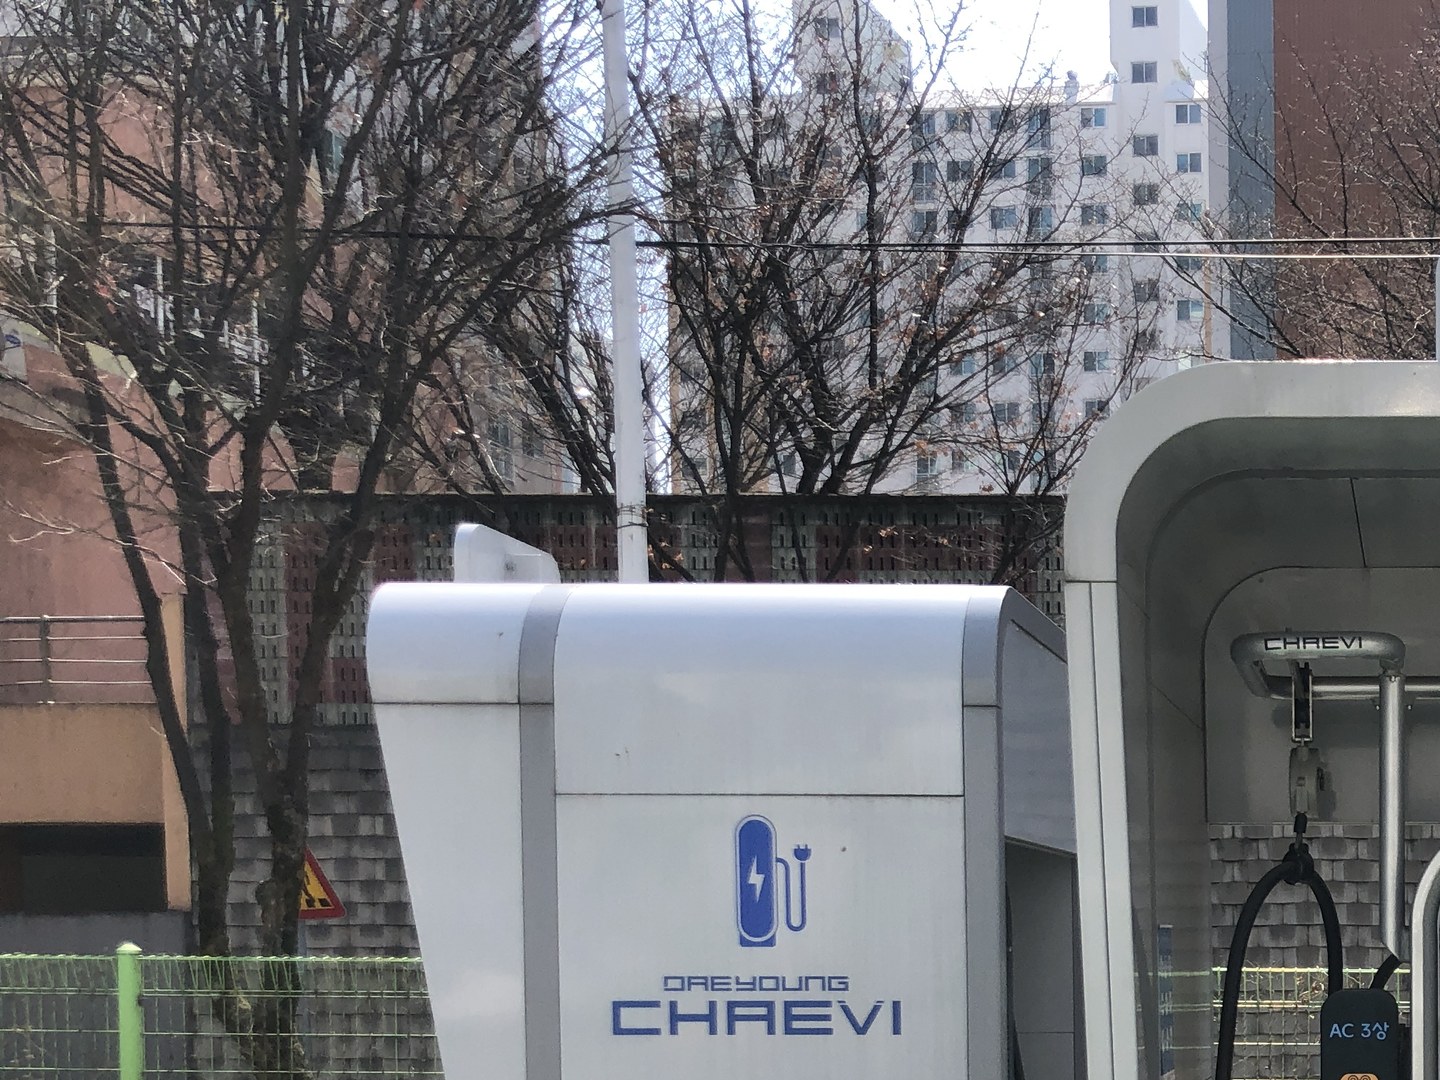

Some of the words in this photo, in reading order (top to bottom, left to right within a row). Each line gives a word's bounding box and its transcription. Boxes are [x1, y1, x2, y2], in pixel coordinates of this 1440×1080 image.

[1263, 636, 1363, 651] CHAEVI
[663, 975, 850, 992] DAEYOUNG
[611, 1000, 902, 1035] CHAEVI
[1329, 1023, 1355, 1038] AC
[1361, 1021, 1390, 1041] 3상
